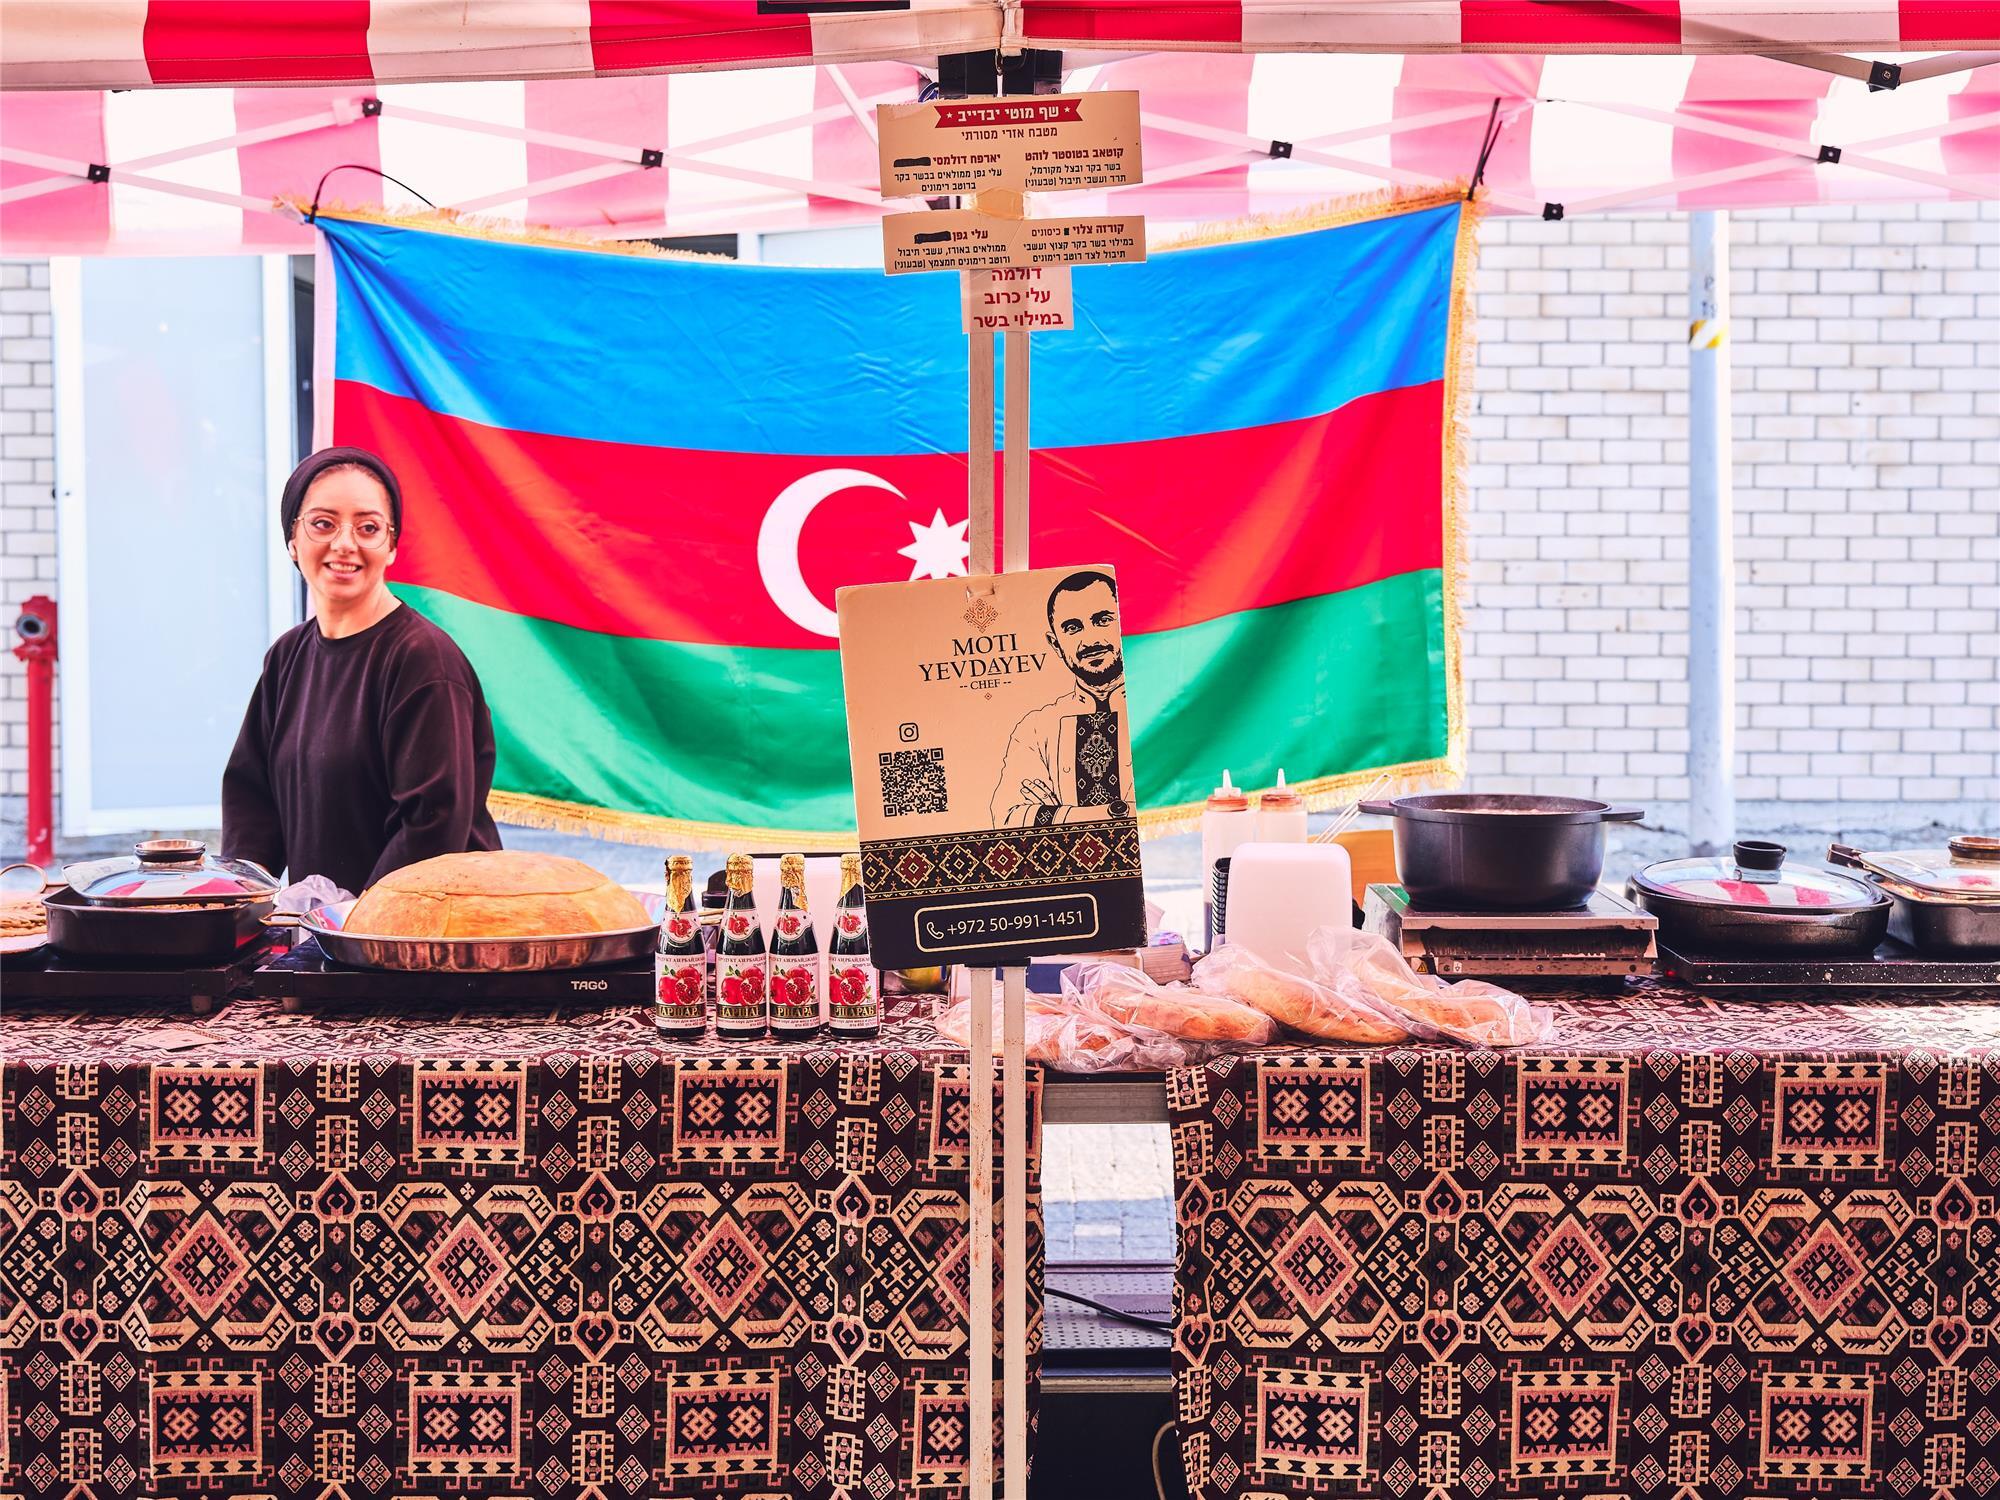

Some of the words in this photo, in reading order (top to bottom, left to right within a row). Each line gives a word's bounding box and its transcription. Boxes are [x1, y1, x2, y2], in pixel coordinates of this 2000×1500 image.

[958, 109, 1000, 122] יבדייב
[1005, 108, 1034, 119] מוטי
[1039, 106, 1059, 120] שף
[961, 130, 998, 140] מסורתי
[1002, 128, 1024, 139] אזרי
[1029, 127, 1057, 138] מטבח
[1025, 150, 1049, 161] לוהט
[1052, 149, 1089, 159] בטוסטר
[1092, 148, 1124, 158] קוטאב
[933, 154, 967, 165] דולמסי
[1064, 164, 1083, 173] ובצל
[1086, 164, 1102, 173] בקר
[1104, 163, 1121, 171] בשר
[913, 172, 935, 180] בבשר
[938, 169, 971, 179] ממולאים
[974, 170, 986, 179] גפן
[988, 168, 1002, 177] עלי
[894, 173, 910, 183] בקר
[1059, 176, 1081, 185] תיבול
[1084, 175, 1107, 184] ועשבי
[921, 183, 950, 192] רימונים
[952, 182, 976, 191] ברוטב
[971, 228, 989, 239] עלי
[1031, 227, 1061, 237] כיסונים
[1073, 223, 1093, 234] צלוי
[1095, 223, 1124, 234] קורזה
[952, 231, 968, 242] גפן
[1109, 237, 1134, 246] במילוי
[973, 243, 1006, 253] ממולאים
[1023, 242, 1047, 251] ועשבי
[1049, 241, 1069, 251] קצוץ
[1071, 240, 1087, 250] בקר
[1089, 239, 1107, 248] בשר
[898, 247, 920, 257] תיבול
[922, 247, 943, 256] עשבי
[1063, 252, 1082, 261] רוטב
[1084, 250, 1100, 260] לצד
[1103, 249, 1126, 259] תיבול
[958, 257, 986, 266] רימונים
[989, 256, 1011, 264] ורוטב
[992, 267, 1042, 281] דולמה
[984, 292, 1021, 305] כרוב
[1025, 287, 1051, 304] עלי
[973, 315, 1010, 328] בשר
[1014, 310, 1064, 326] במילוי
[952, 633, 1019, 656] MOTI
[918, 653, 1047, 682] YEVDAYEV
[970, 679, 1001, 690] CHEF
[947, 919, 986, 935] +972
[989, 910, 1084, 933] 50-991-1451
[570, 980, 608, 990] TAGO
